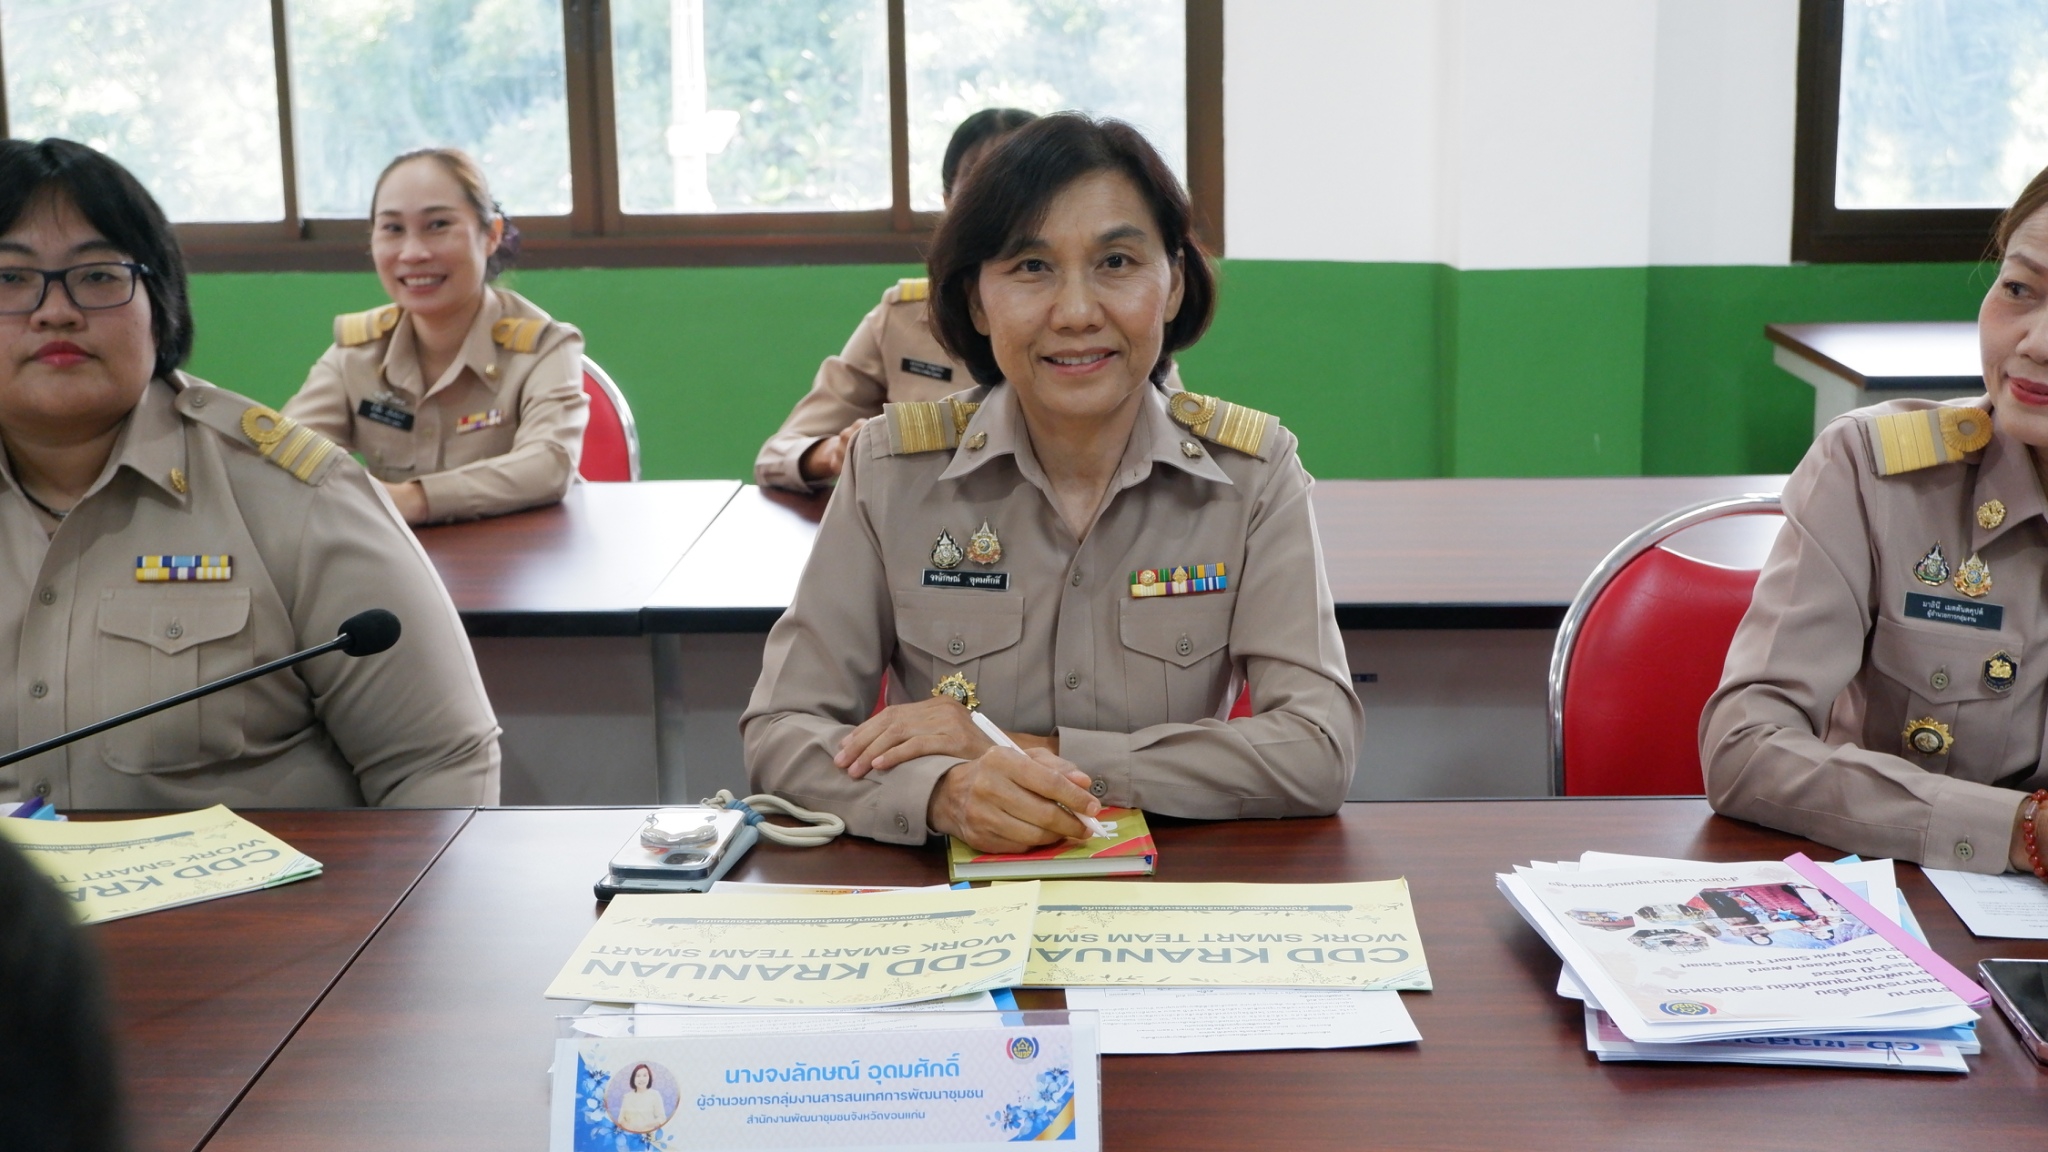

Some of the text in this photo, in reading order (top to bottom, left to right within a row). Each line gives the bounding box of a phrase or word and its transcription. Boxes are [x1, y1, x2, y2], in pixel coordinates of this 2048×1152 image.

[179, 839, 266, 862] WORK
[82, 859, 176, 881] SMART
[172, 849, 281, 879] CDD
[590, 933, 1017, 958] WORK SMART TEAM SMART
[1033, 933, 1408, 943] WORK SMART TEAM SMA
[1027, 947, 1409, 963] CDD KRANUA
[1766, 956, 1811, 964] Smart
[1796, 957, 1873, 969] KhonKaen
[580, 948, 1012, 981] CDD KRANUAN
[1747, 965, 1792, 973] Award
[1667, 984, 1763, 995] ระดับจังหวัด
[1887, 986, 1953, 997] รายงาน
[725, 1053, 961, 1085] นางจงลักษณ์ อุดมศักดิ์
[696, 1087, 984, 1110] ผู้อำนวยการกลุ่มงานสารสนเทศการพัฒนาชุมชน
[746, 1109, 925, 1125] สำนักงานพัฒนาชุมชนจังหวัดขอนแก่น
